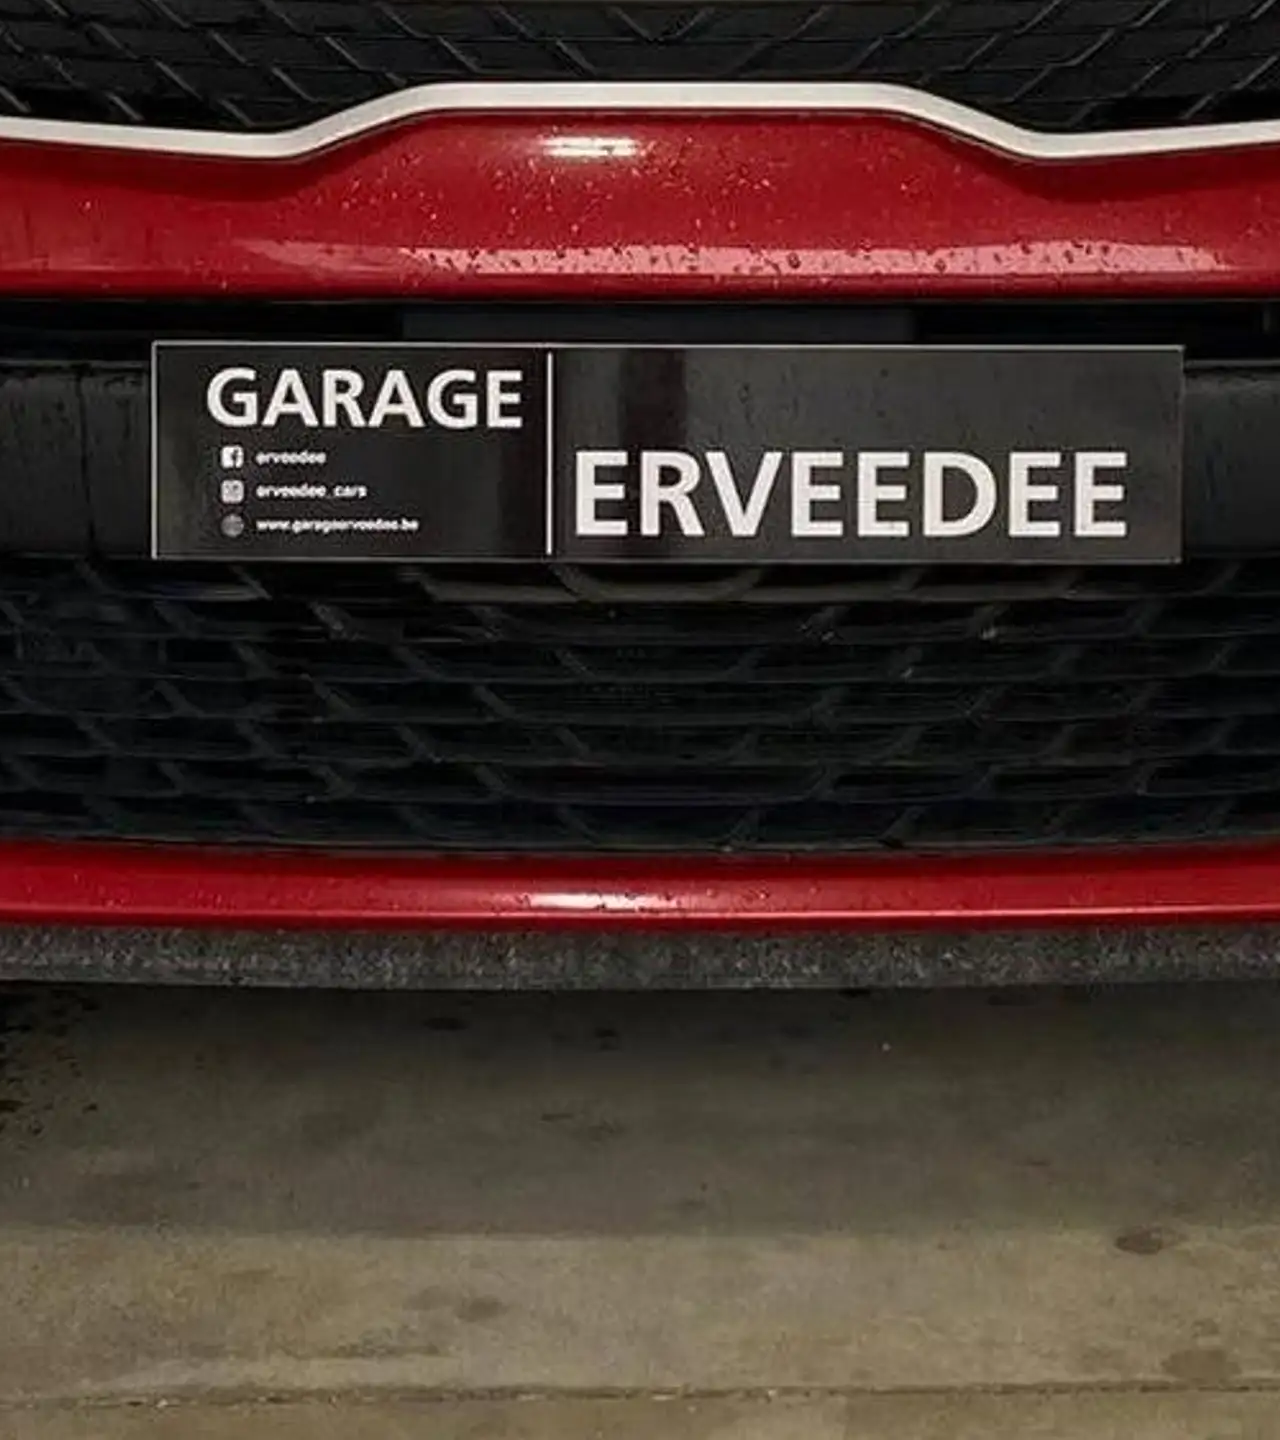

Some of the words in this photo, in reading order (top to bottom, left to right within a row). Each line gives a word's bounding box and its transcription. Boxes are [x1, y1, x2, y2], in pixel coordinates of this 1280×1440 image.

[206, 367, 523, 430] GARAGE
[255, 450, 327, 466] erveedee
[575, 450, 1128, 538] ERVEEDEE
